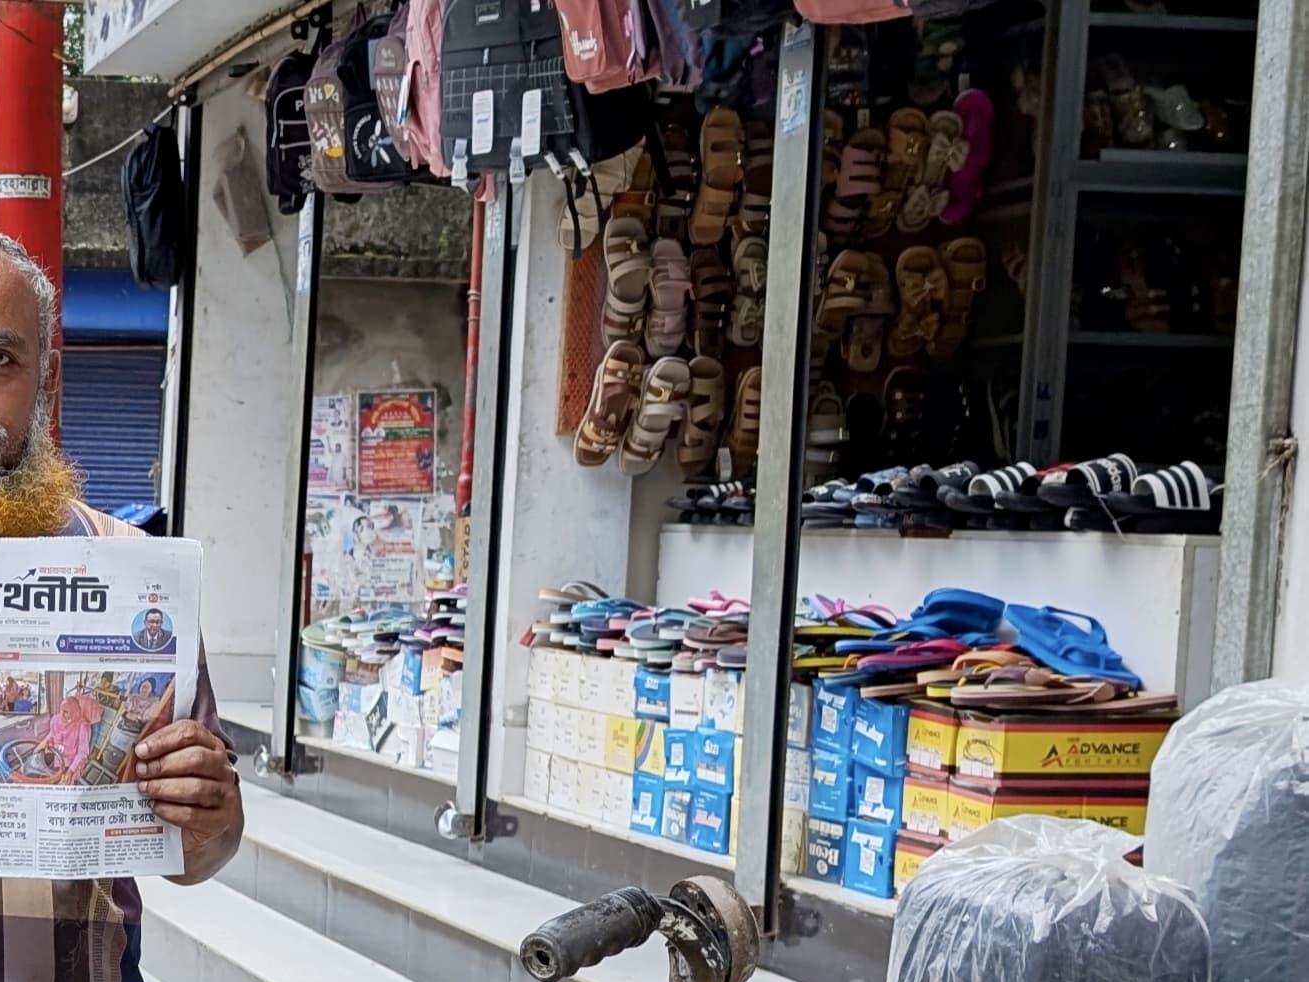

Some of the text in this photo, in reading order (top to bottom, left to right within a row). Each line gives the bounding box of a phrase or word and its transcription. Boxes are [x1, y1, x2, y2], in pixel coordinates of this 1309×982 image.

[1068, 742, 1140, 755] ADVANCE
[45, 801, 78, 813] সরকার
[81, 797, 133, 811] অপ্রয়োজনীয়
[69, 815, 105, 826] কমানোর
[108, 812, 127, 825] চেষ্টা
[130, 813, 156, 824] করছে
